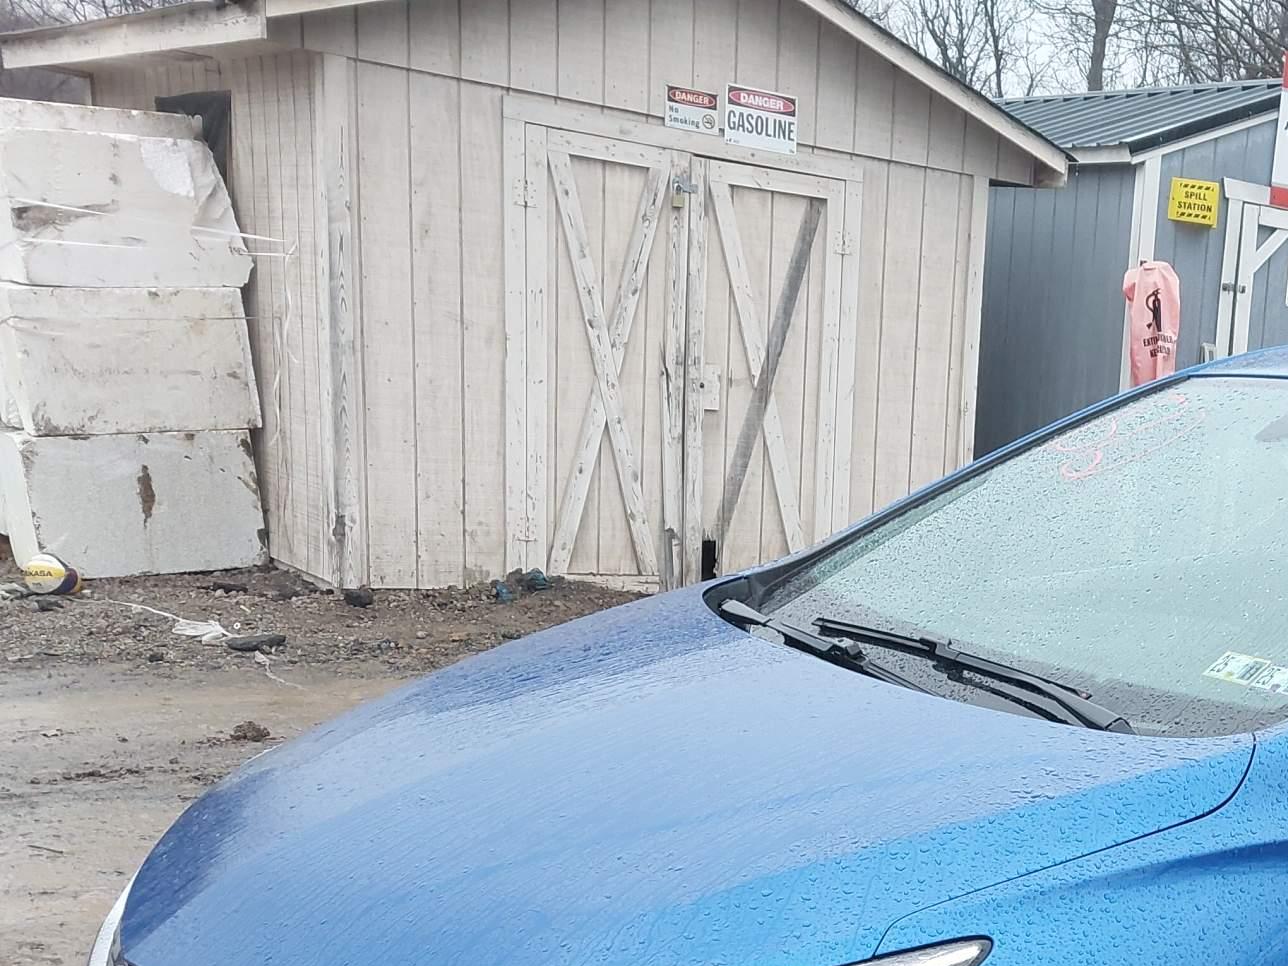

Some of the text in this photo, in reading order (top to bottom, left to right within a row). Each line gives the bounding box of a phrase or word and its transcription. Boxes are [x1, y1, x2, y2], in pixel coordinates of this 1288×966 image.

[675, 91, 709, 105] DANGER
[740, 92, 784, 110] DANGER
[668, 104, 679, 113] No
[668, 114, 700, 129] Smoking
[727, 109, 796, 142] GASOLINE
[1184, 190, 1208, 201] SPILL
[1177, 200, 1213, 213] STATION
